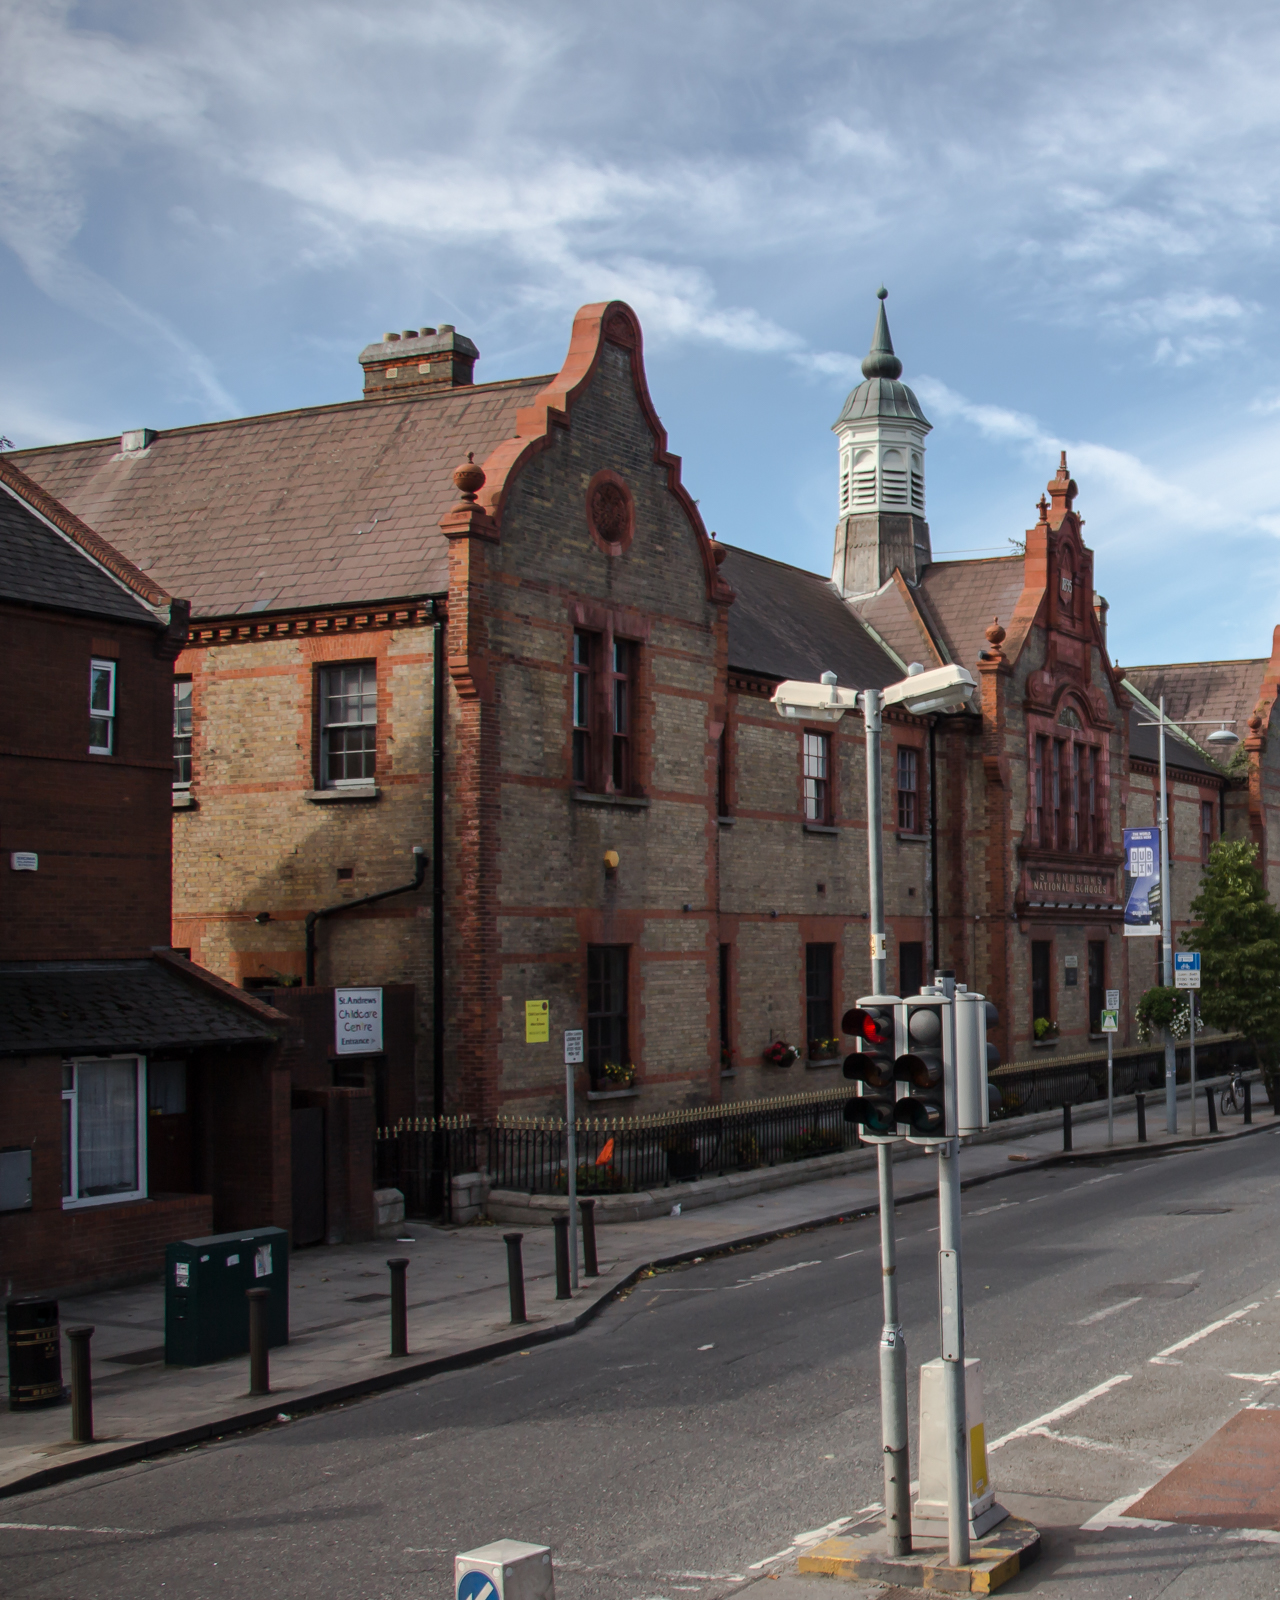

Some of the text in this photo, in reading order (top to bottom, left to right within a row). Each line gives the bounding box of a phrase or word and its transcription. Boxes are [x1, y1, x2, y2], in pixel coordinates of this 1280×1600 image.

[1033, 881, 1107, 895] NATIONAL SCHOOLS
[338, 1009, 378, 1019] Childcare
[344, 1022, 373, 1032] Centre
[341, 1037, 370, 1046] Entrance
